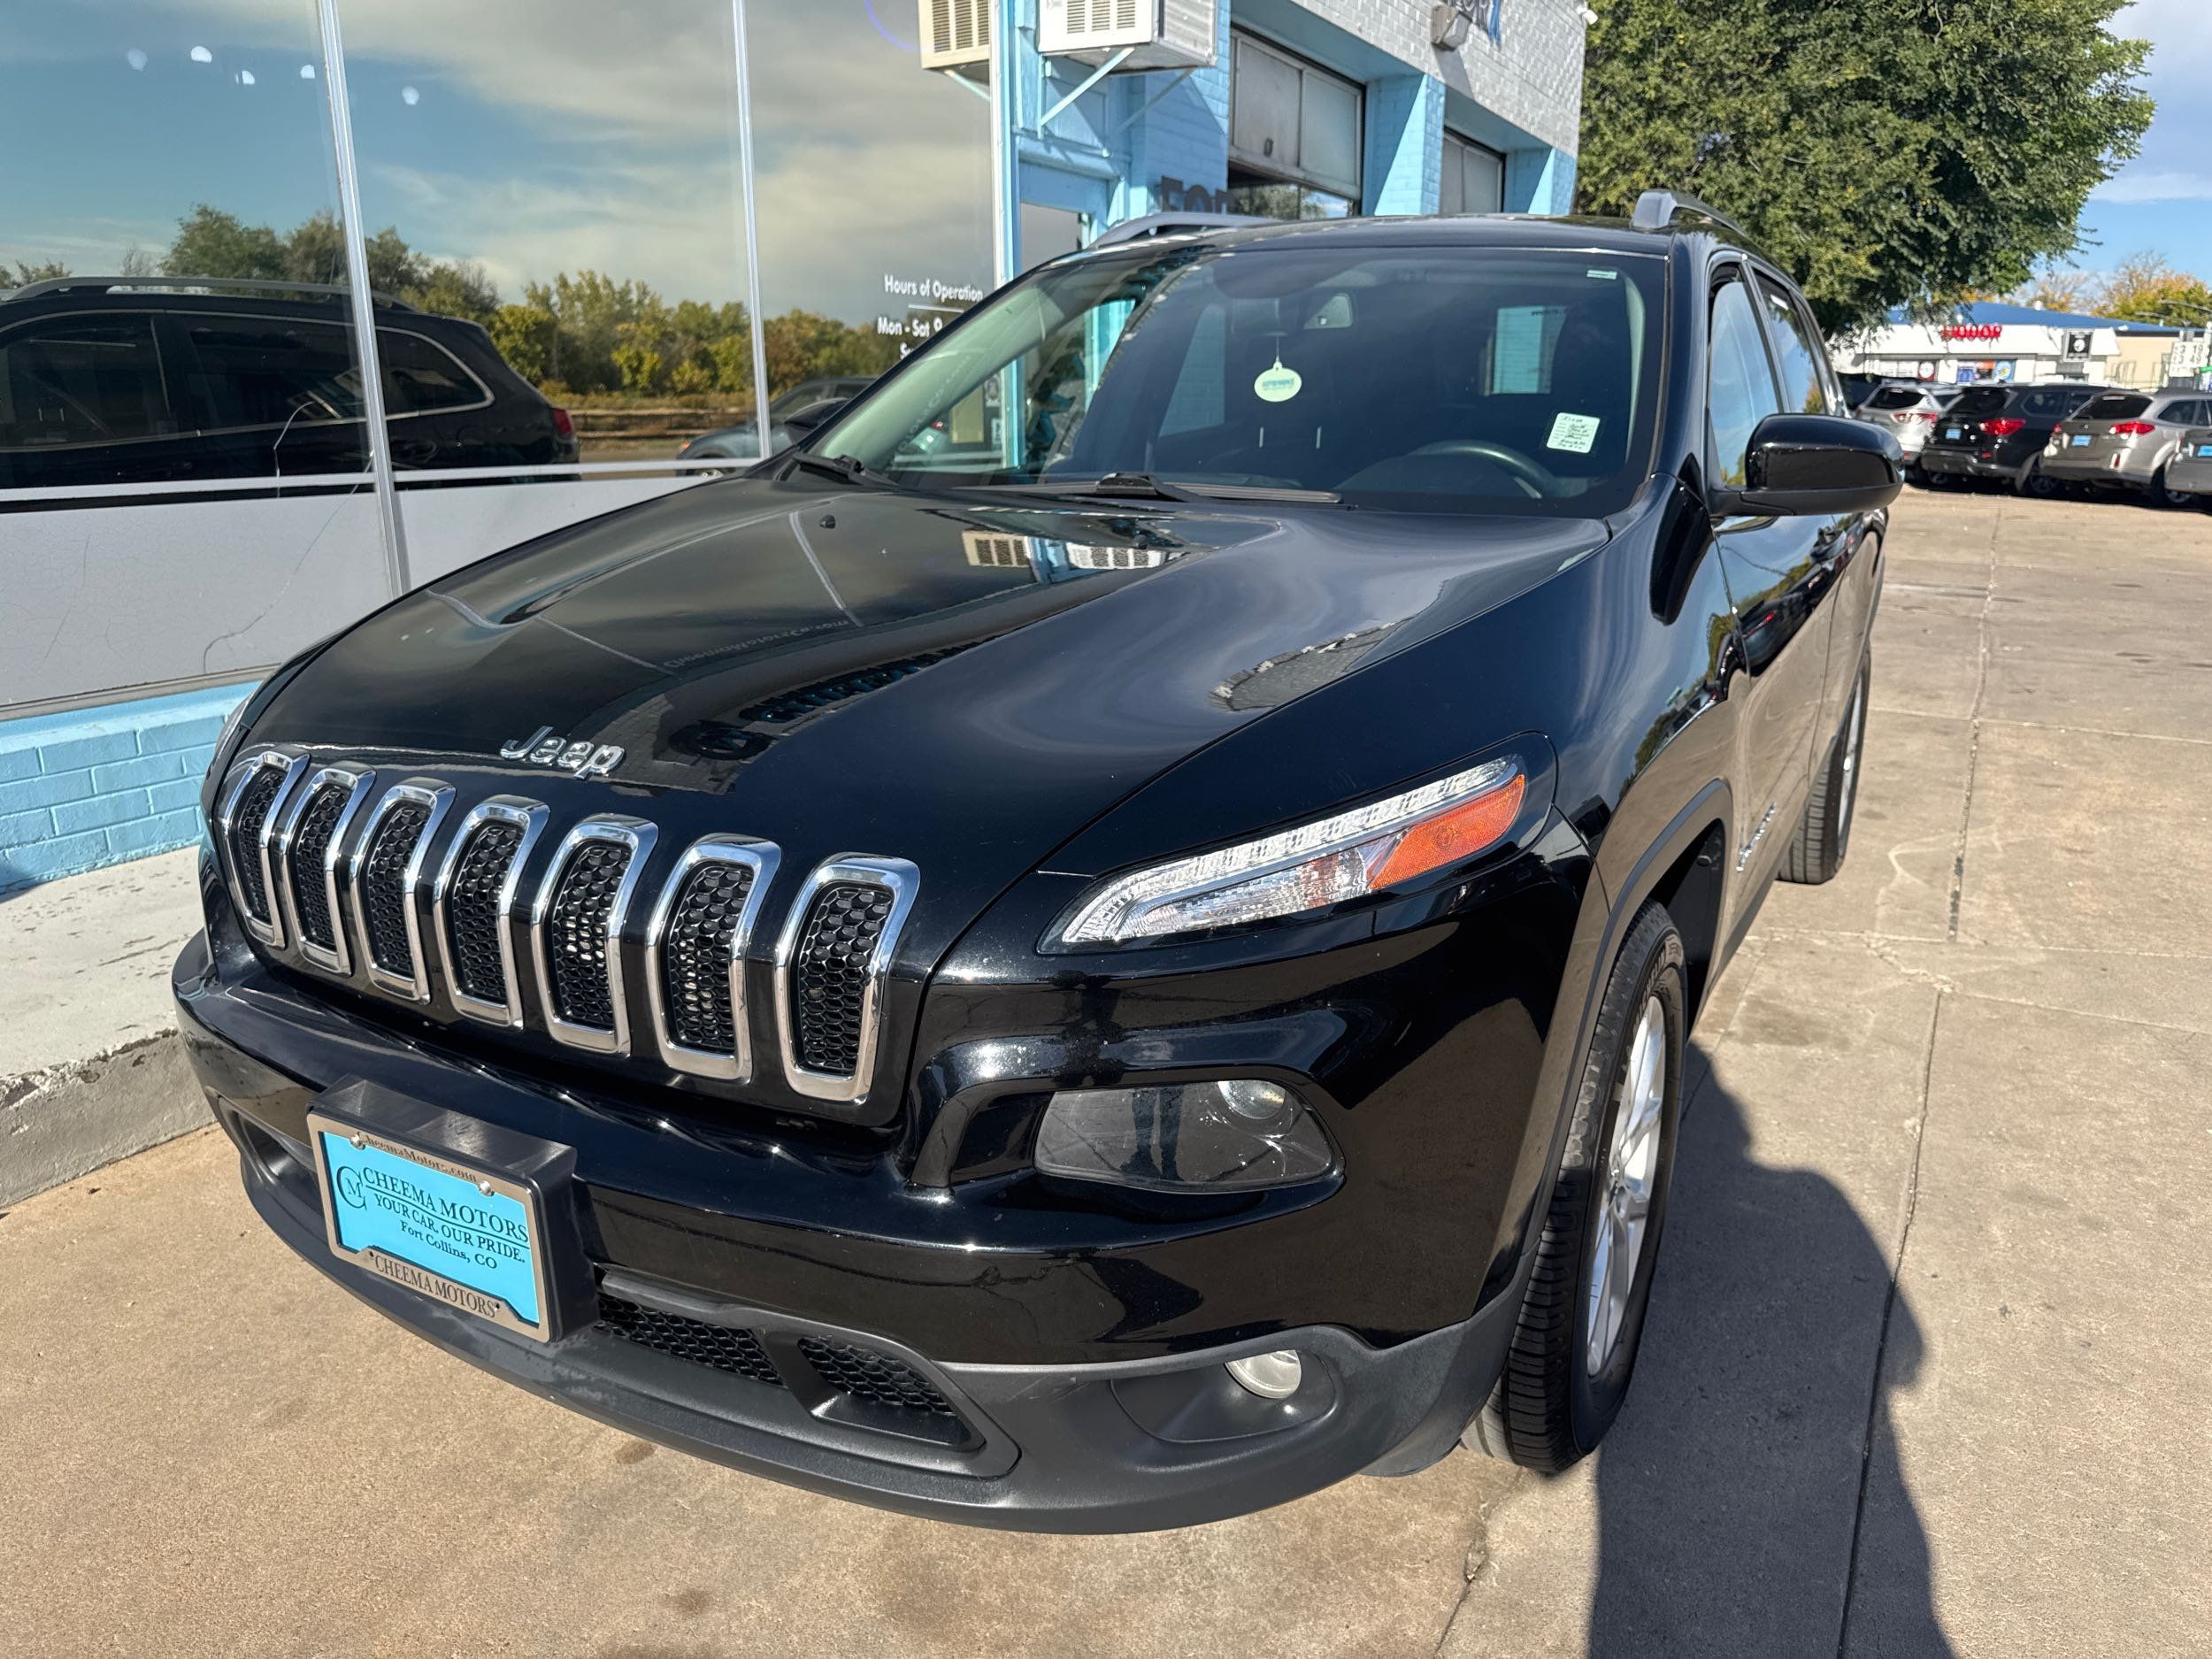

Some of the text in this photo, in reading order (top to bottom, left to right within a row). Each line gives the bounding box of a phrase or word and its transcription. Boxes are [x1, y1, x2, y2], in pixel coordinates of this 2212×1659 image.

[885, 274, 983, 303] Hours of Operation
[878, 317, 902, 335] Mon
[912, 319, 930, 337] Sat
[500, 726, 625, 780] Jeep
[364, 1167, 529, 1243] CHEEMA MOTORS
[373, 1193, 410, 1219] YOUR
[442, 1225, 474, 1247] OUR
[477, 1234, 526, 1263] PRIDE.
[400, 1219, 498, 1270] Fort Collins, CO
[375, 1255, 495, 1318] CHEEMA MOTORS
